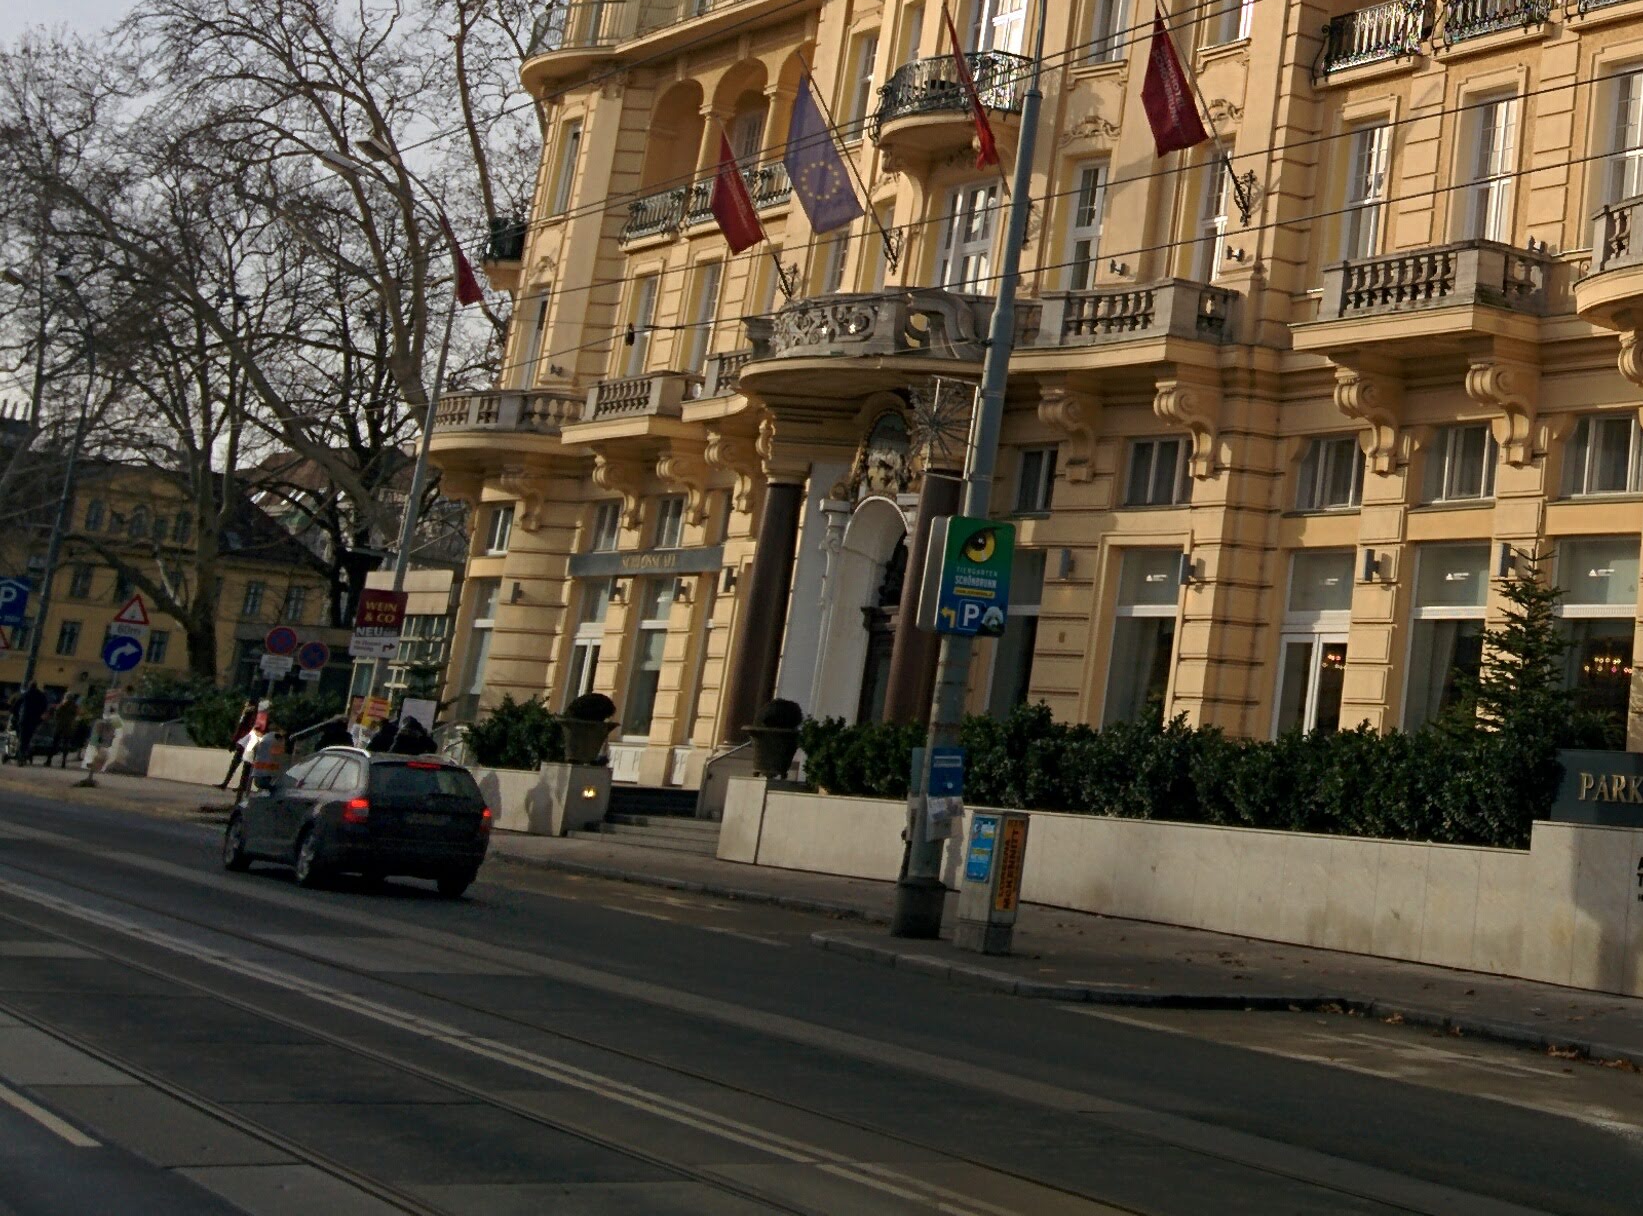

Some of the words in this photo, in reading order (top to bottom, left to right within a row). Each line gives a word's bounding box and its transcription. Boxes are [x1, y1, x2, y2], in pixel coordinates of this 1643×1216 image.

[366, 600, 398, 612] WEIN
[377, 613, 396, 624] CO
[356, 626, 383, 637] NEU
